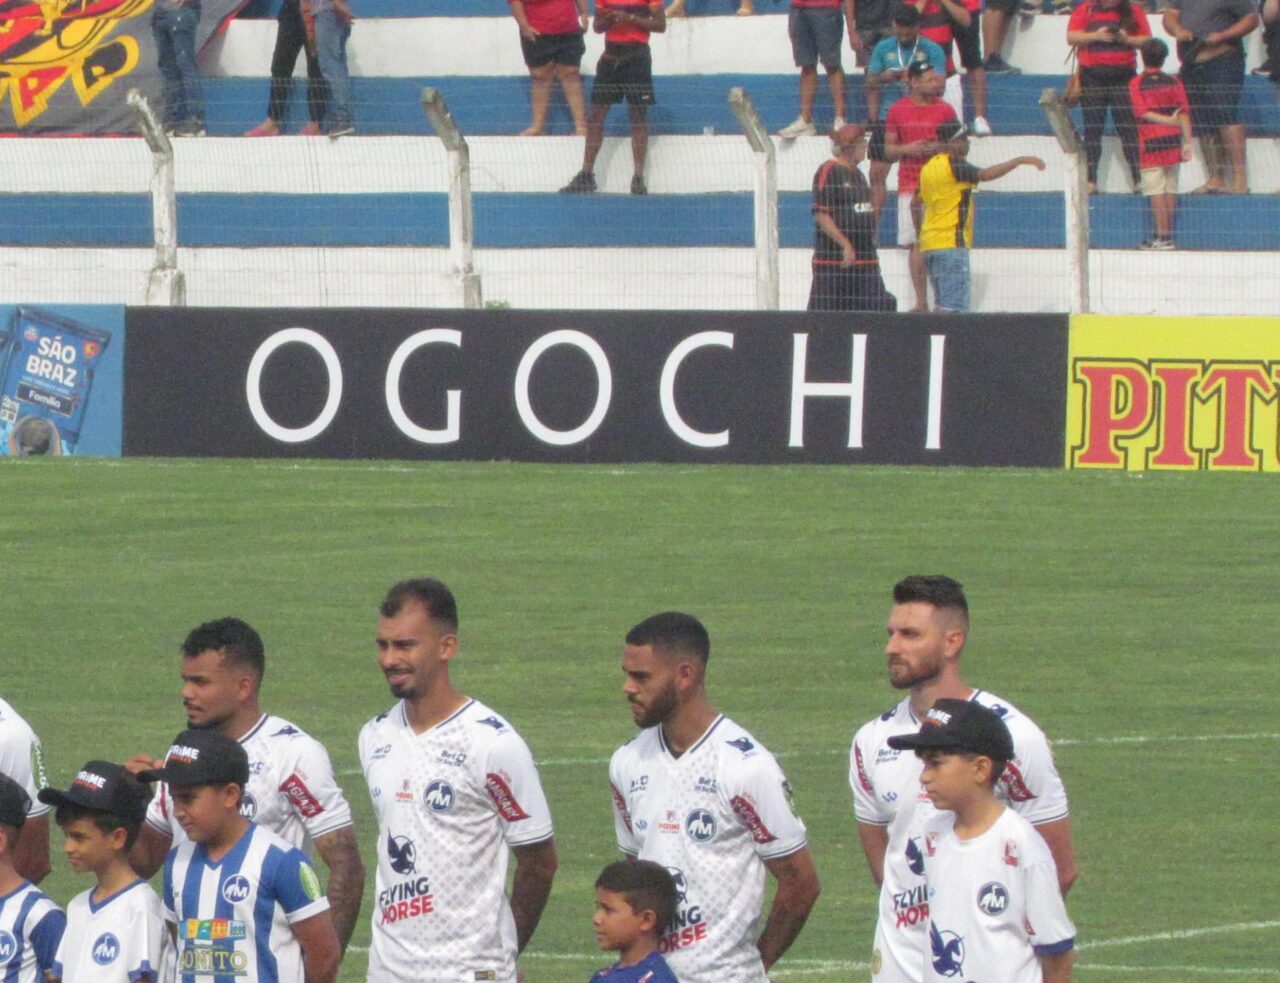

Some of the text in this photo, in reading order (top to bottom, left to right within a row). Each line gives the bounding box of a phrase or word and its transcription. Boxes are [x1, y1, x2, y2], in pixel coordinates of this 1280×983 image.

[26, 355, 77, 388] BRAZ
[1072, 357, 1280, 472] PIT
[379, 876, 430, 907] FLYING
[381, 894, 434, 926] HORSE
[658, 922, 708, 955] ORSE
